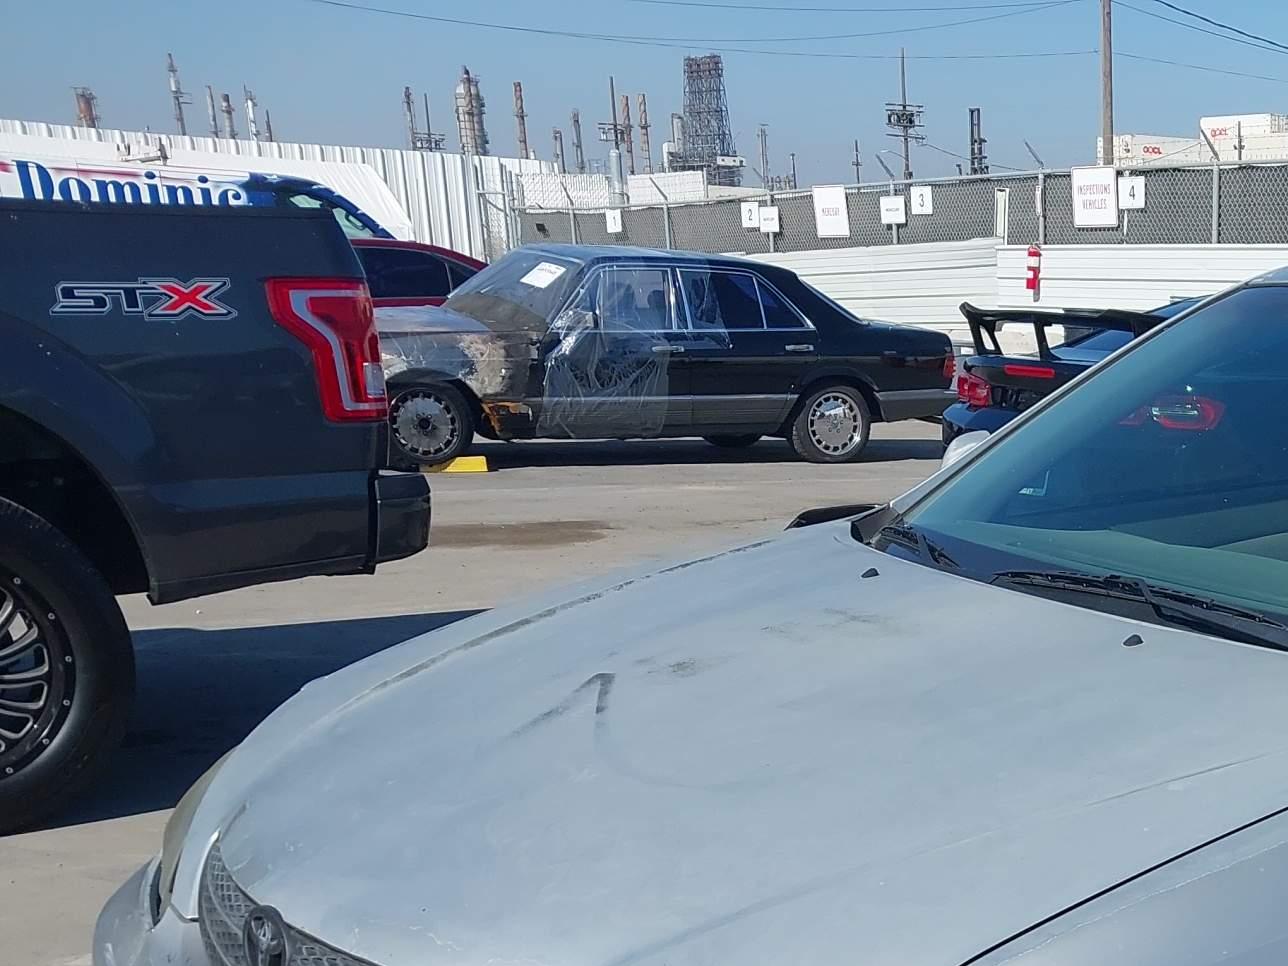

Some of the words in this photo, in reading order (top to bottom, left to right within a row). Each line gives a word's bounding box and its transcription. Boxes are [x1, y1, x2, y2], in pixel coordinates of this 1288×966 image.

[1077, 183, 1111, 196] INSPECTIONS
[1128, 185, 1136, 200] 4
[918, 193, 926, 208] 3
[1081, 198, 1108, 210] VEHICLES
[747, 208, 753, 221] 2
[612, 216, 617, 227] 1
[50, 277, 239, 321] STX
